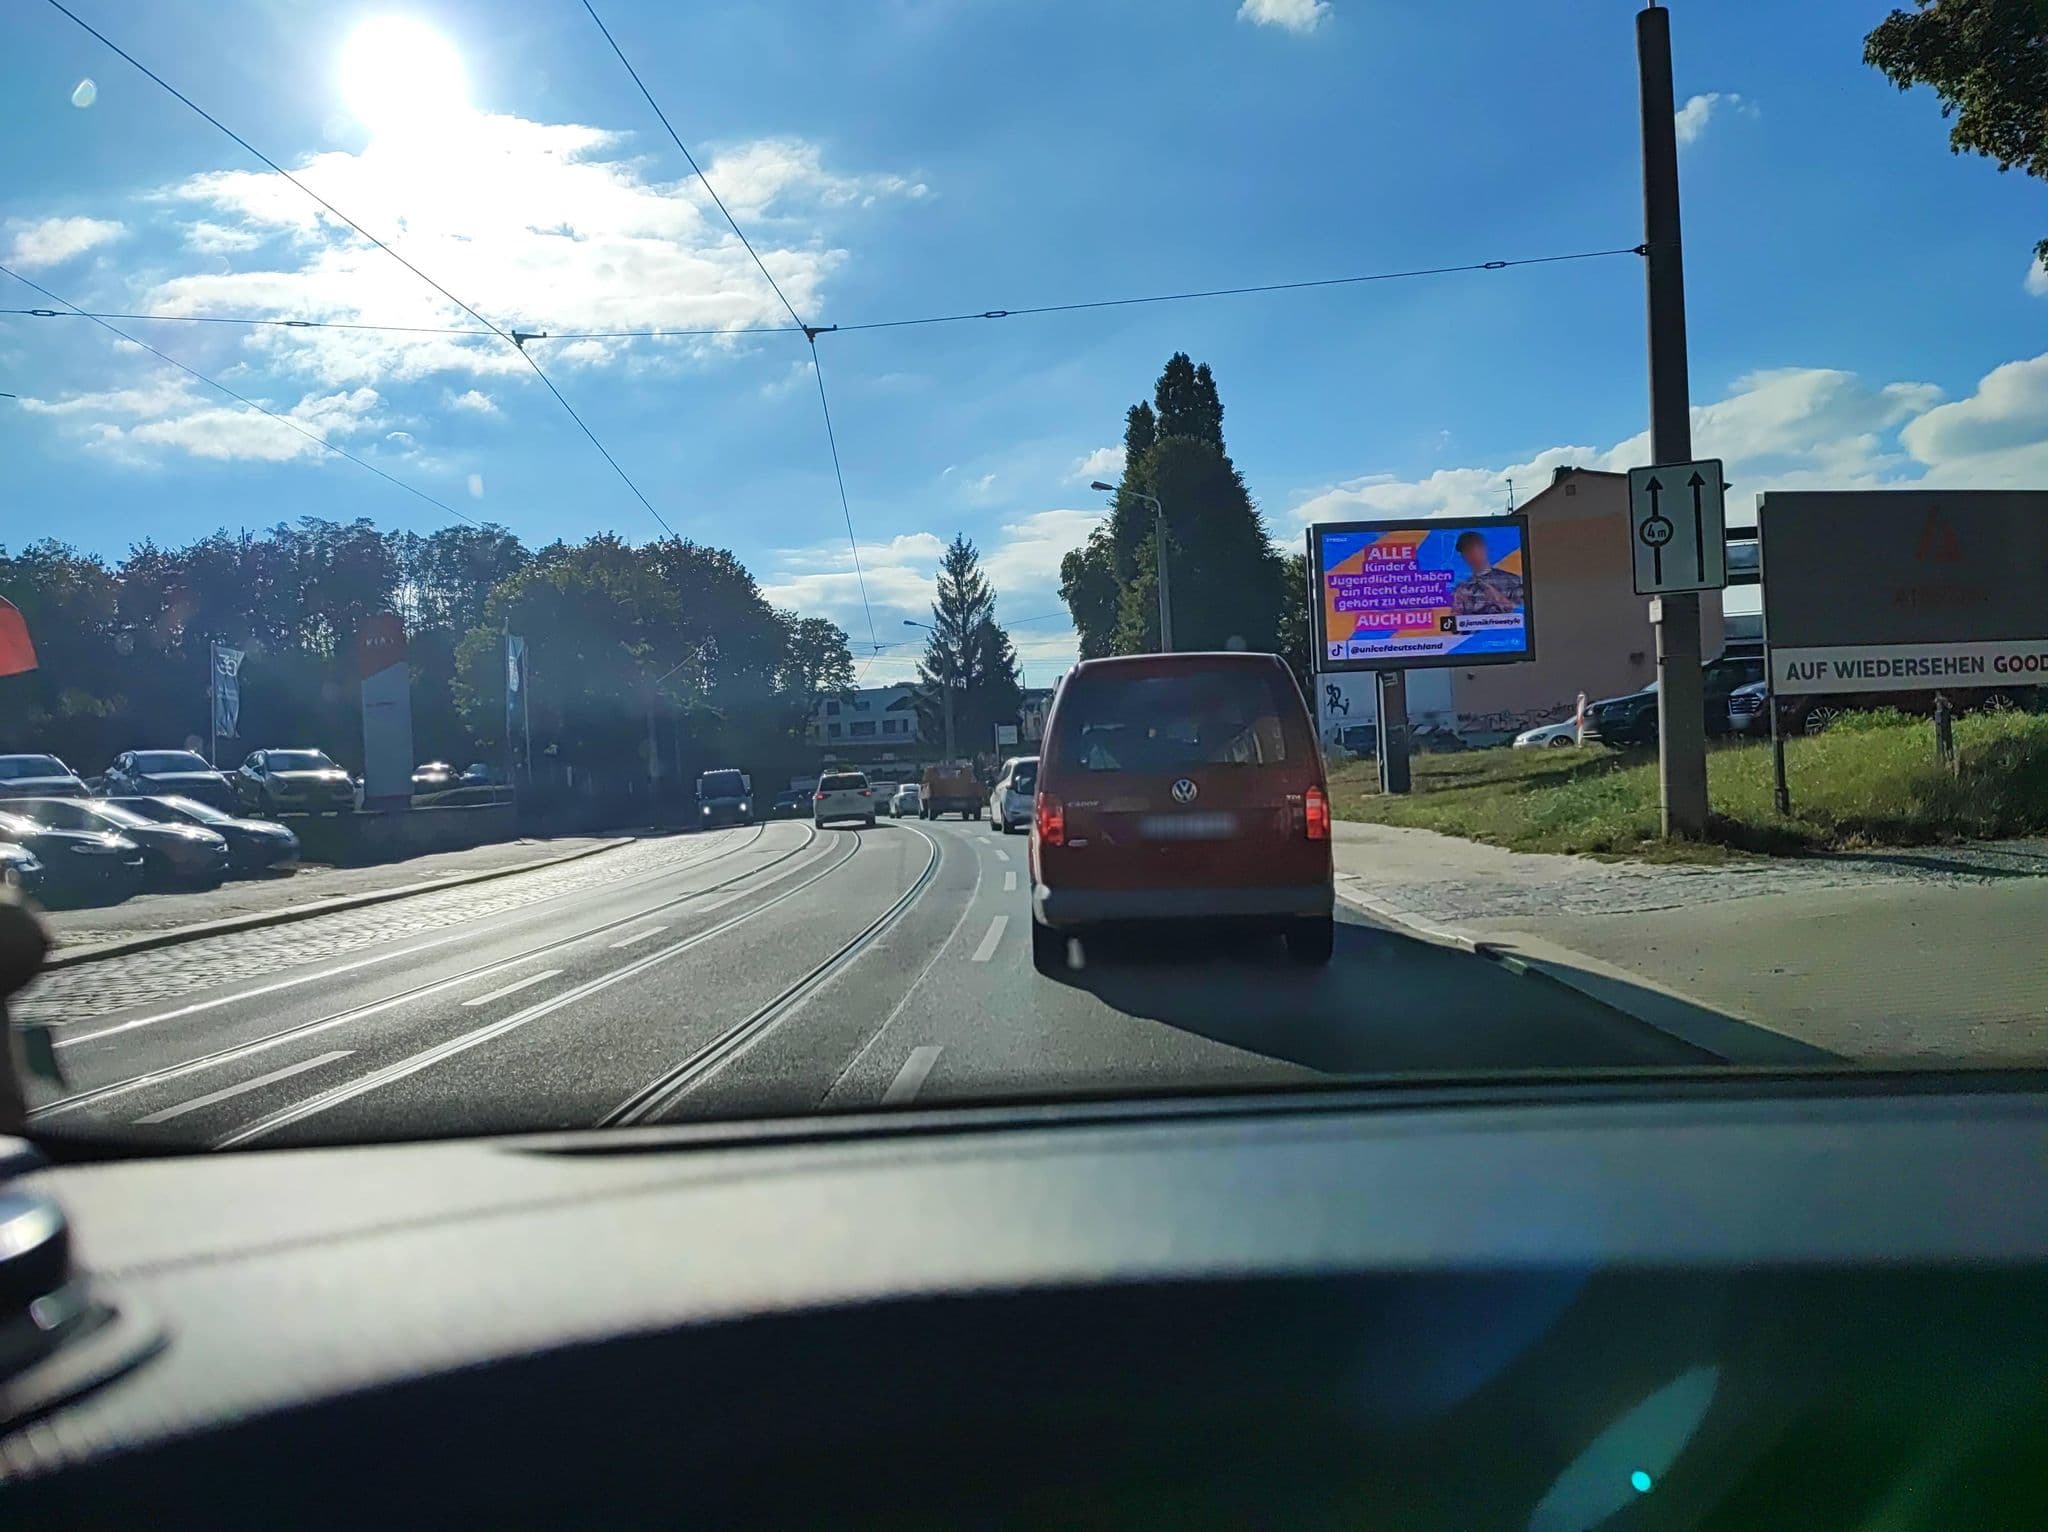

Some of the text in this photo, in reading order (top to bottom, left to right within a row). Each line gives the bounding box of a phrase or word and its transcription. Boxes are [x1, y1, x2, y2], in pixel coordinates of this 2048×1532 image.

[1368, 546, 1412, 561] ALLE
[1365, 561, 1417, 573] Kinder &
[1330, 571, 1452, 587] Jugendlichen haben
[1341, 583, 1442, 596] ein Recht darauf,
[1381, 598, 1396, 606] zu
[1398, 595, 1447, 605] werden.
[1356, 612, 1432, 627] AUCH DU!
[1351, 642, 1443, 655] @unicefdeutschland
[1786, 661, 1828, 681] AUF
[1833, 655, 1985, 679] WIEDERSEHEN
